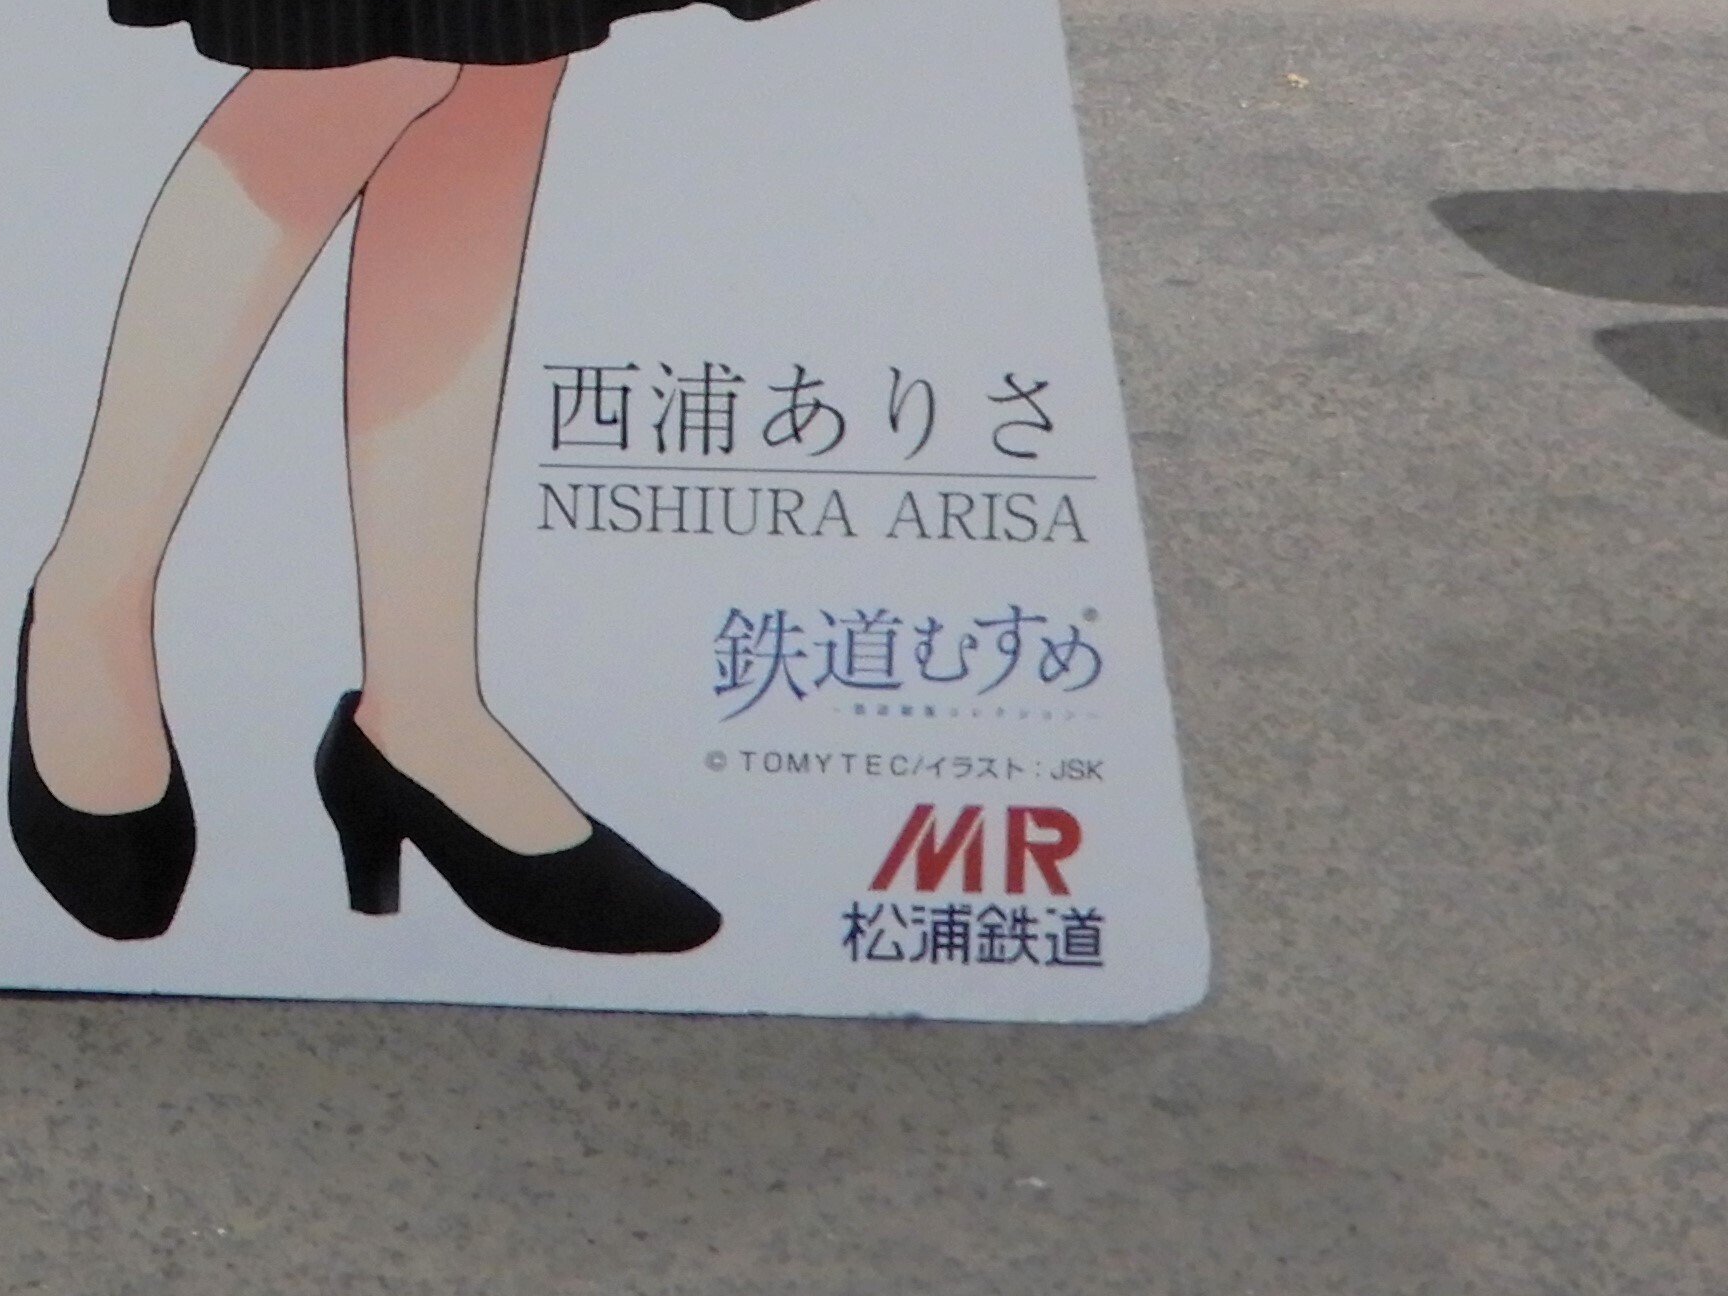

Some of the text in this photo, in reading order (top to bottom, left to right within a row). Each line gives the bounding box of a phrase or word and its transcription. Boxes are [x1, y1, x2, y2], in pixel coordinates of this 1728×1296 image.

[542, 360, 1055, 461] 西浦ありさ
[537, 482, 1089, 544] NISHIURA ARISA
[713, 603, 1103, 723] 鉄道むすめ
[867, 802, 1083, 896] MR
[842, 901, 1104, 967] 松浦鉄道
